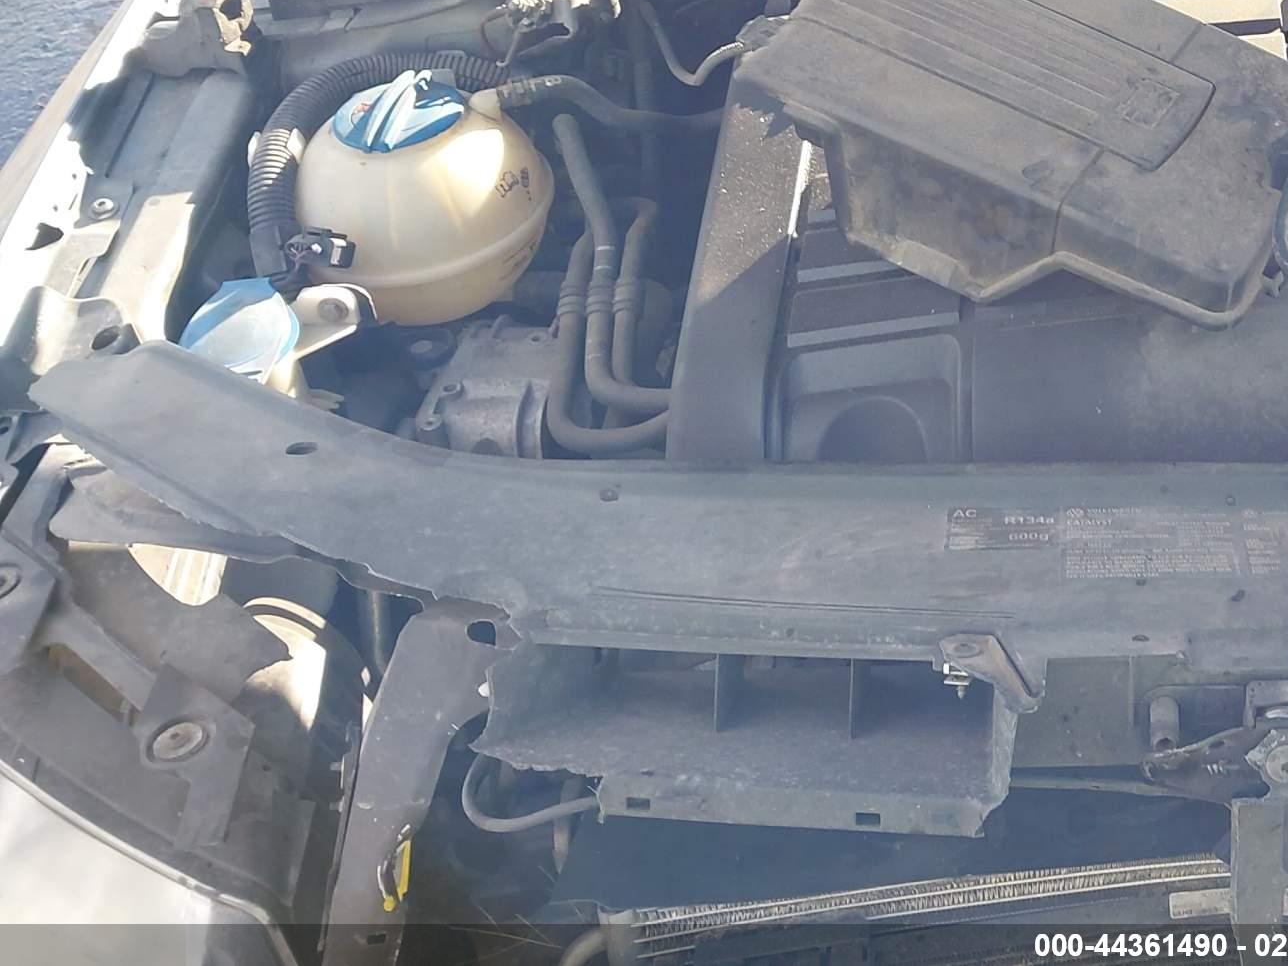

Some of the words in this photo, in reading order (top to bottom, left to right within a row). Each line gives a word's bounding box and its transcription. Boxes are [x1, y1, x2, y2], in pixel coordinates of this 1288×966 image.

[953, 509, 977, 518] AC
[1004, 516, 1054, 524] R134a
[1009, 532, 1049, 540] 600g
